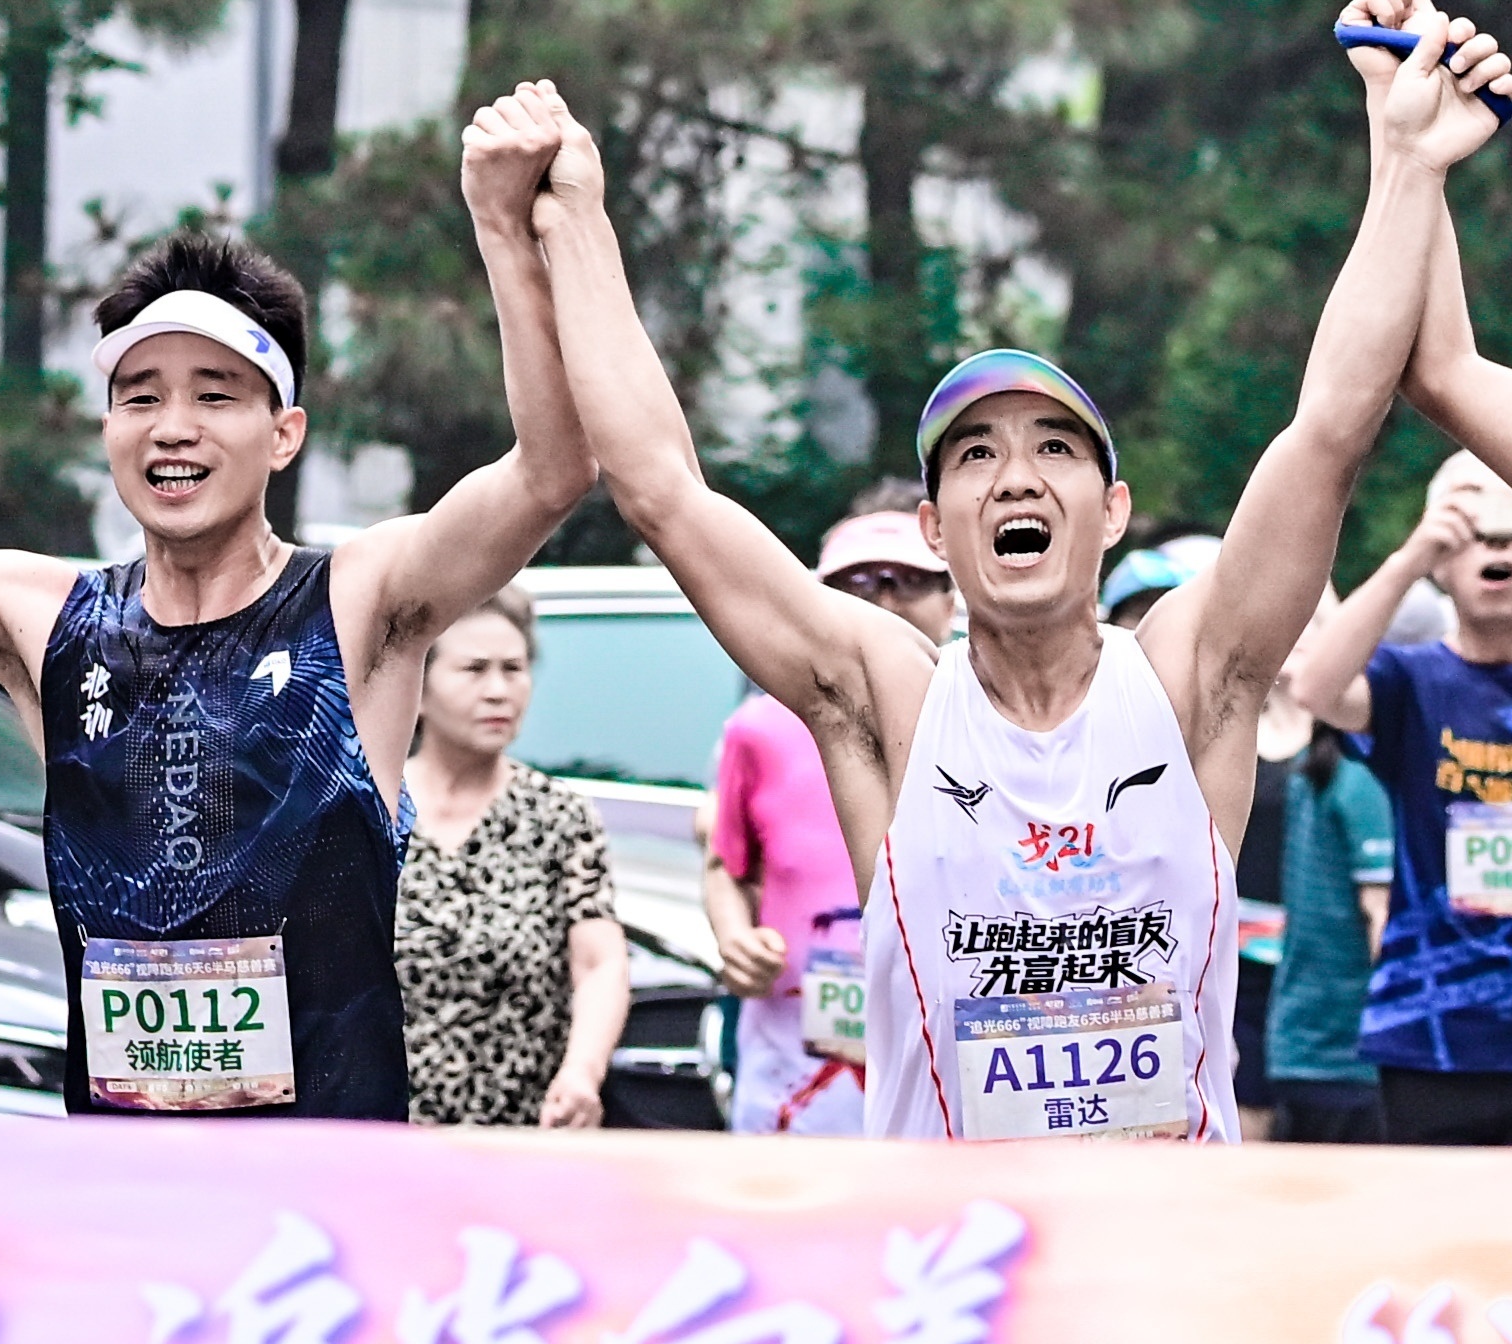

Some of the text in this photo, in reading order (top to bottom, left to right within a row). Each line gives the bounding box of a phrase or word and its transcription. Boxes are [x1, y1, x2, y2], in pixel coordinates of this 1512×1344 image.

[164, 691, 203, 871] NEDAO
[948, 911, 1170, 958] 让跑起来的盲友
[978, 950, 1148, 997] 先富起来
[101, 986, 265, 1034] P0112
[819, 981, 865, 1015] P0
[124, 1038, 245, 1073] 领航使者
[982, 1033, 1161, 1094] A1126
[1044, 1093, 1109, 1130] 雷达
